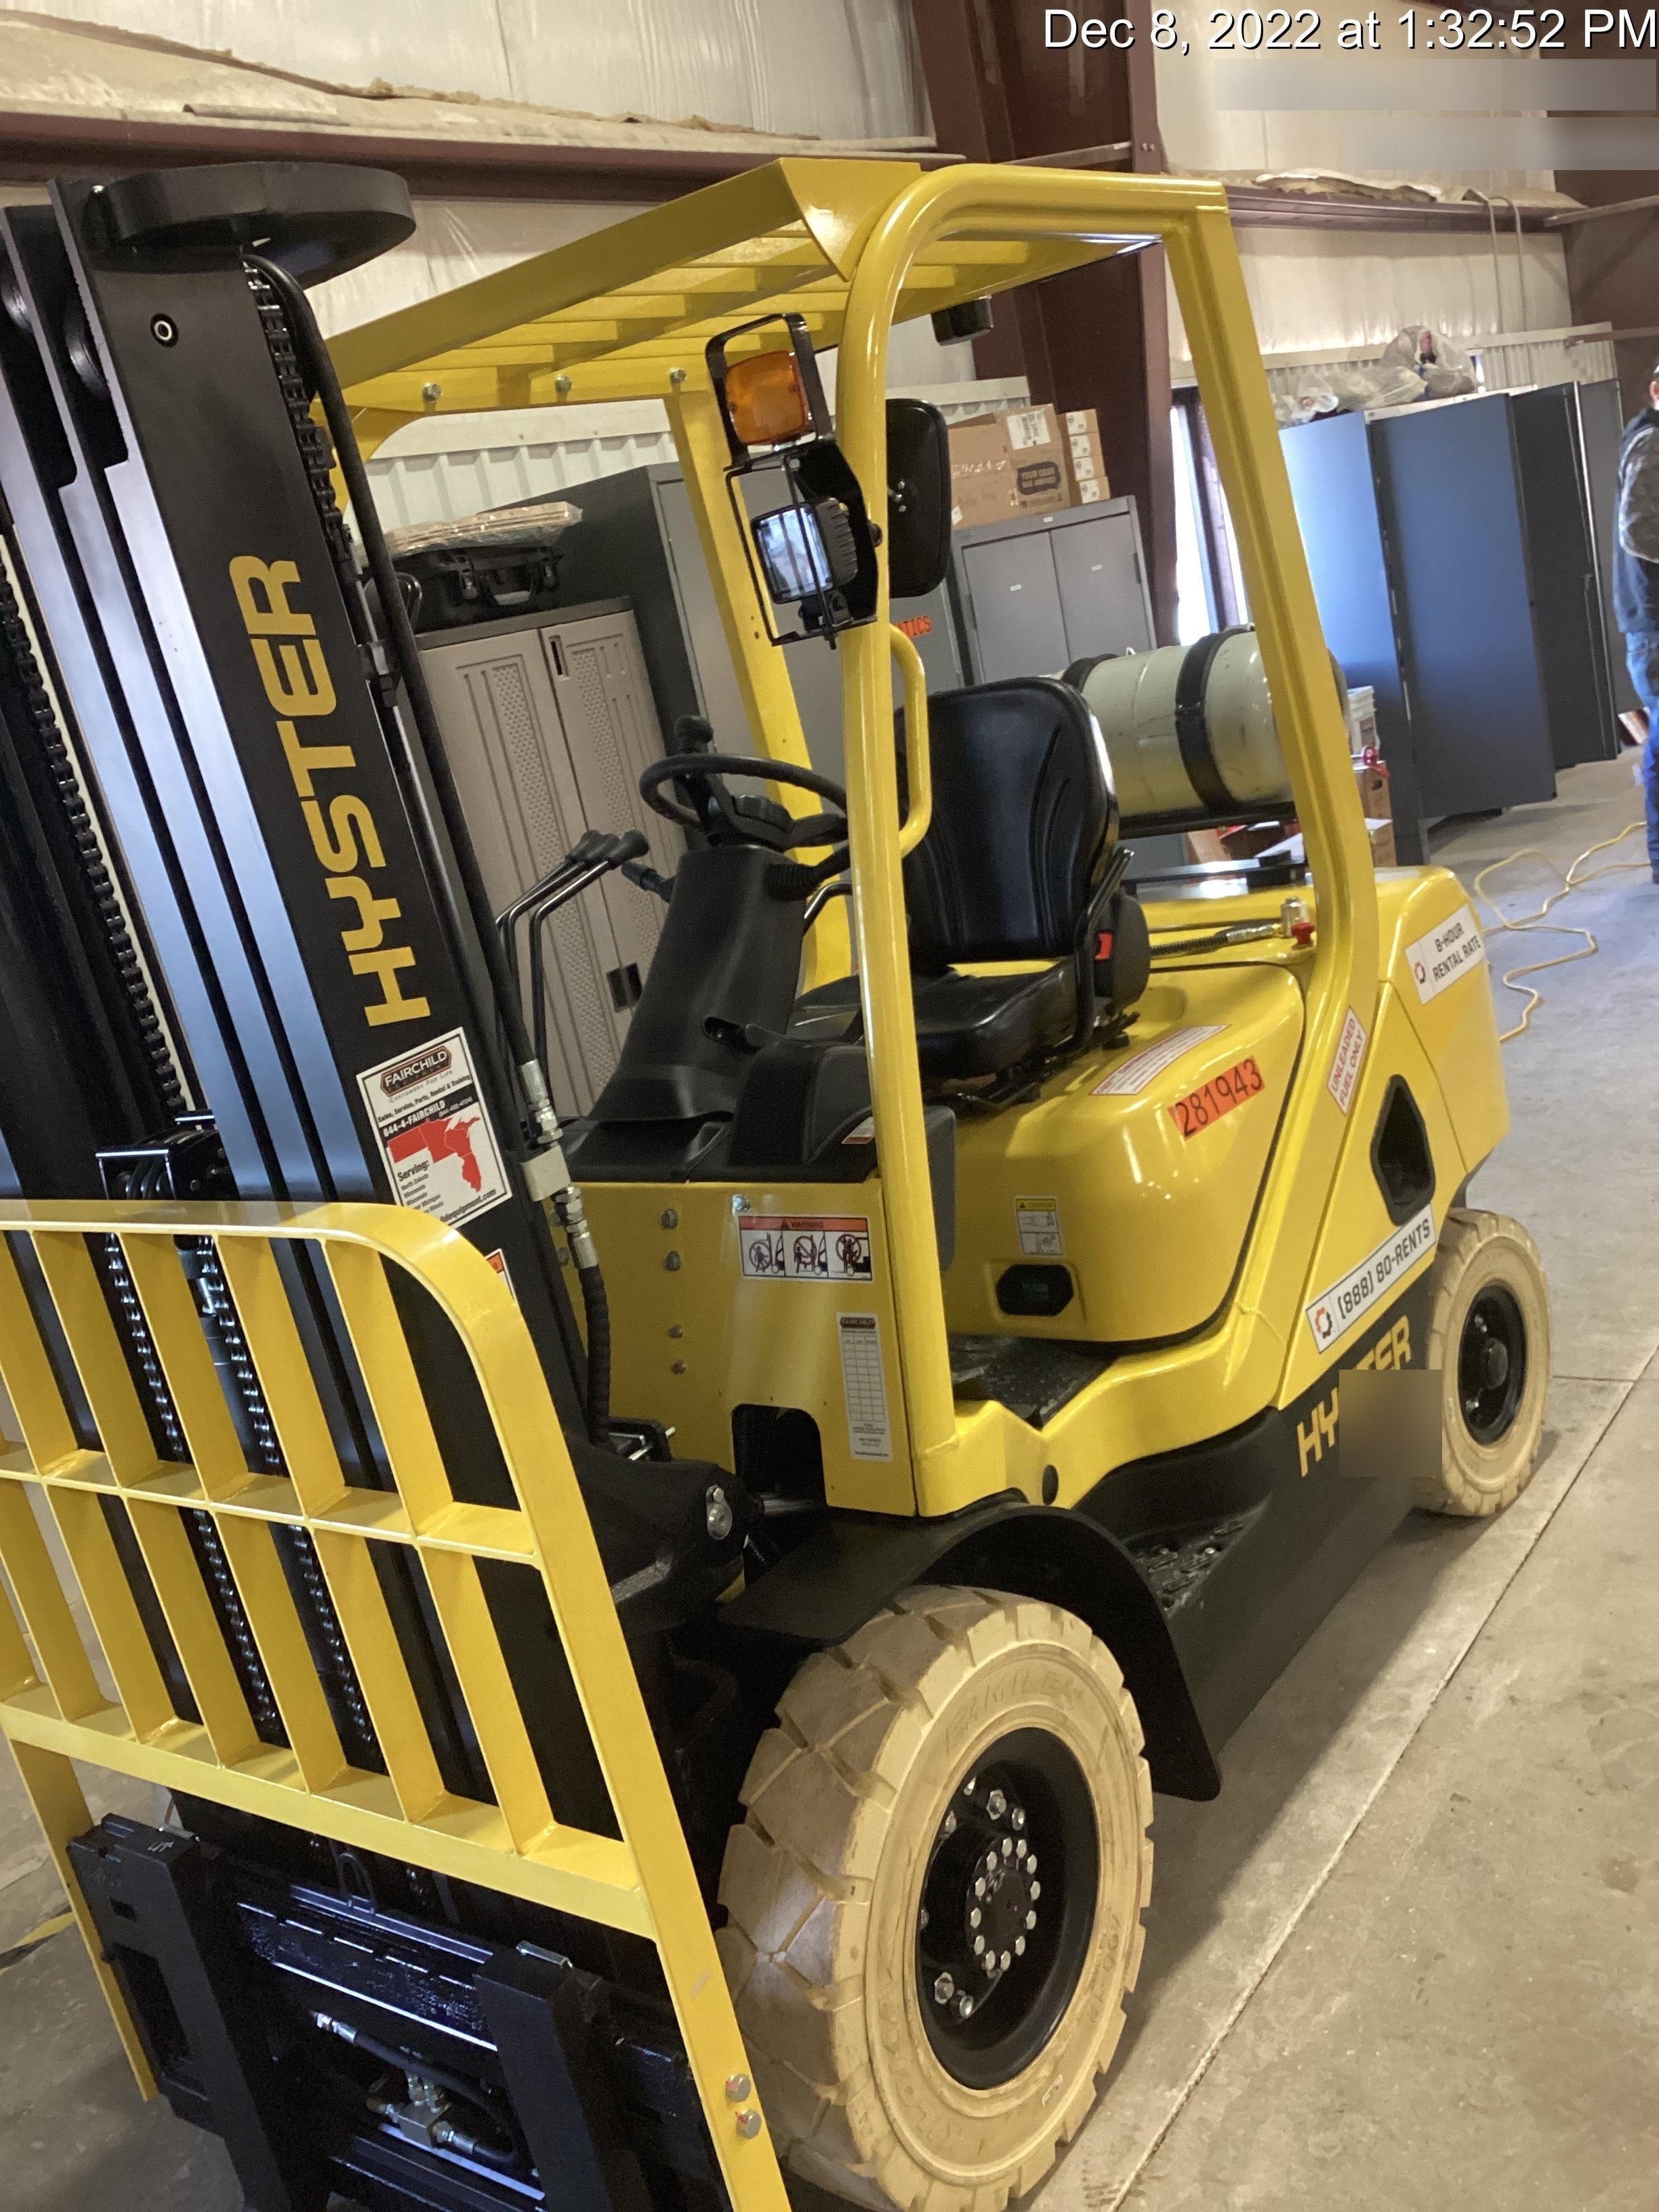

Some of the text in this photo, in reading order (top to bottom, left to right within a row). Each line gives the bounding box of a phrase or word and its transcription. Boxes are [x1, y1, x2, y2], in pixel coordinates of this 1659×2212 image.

[229, 556, 431, 1027] HYSTER
[1433, 935, 1481, 981] RENTAL RATE
[384, 1050, 447, 1087] FAIRCHILD
[1331, 1017, 1357, 1093] UNLEADED
[1339, 1032, 1366, 1107] FUEL ONLY
[383, 1100, 446, 1137] 844-4-FAIRCHILD
[1175, 1058, 1264, 1137] 281943
[397, 1160, 430, 1181] Serving:
[1337, 1218, 1431, 1319] (888) 80-RENTS
